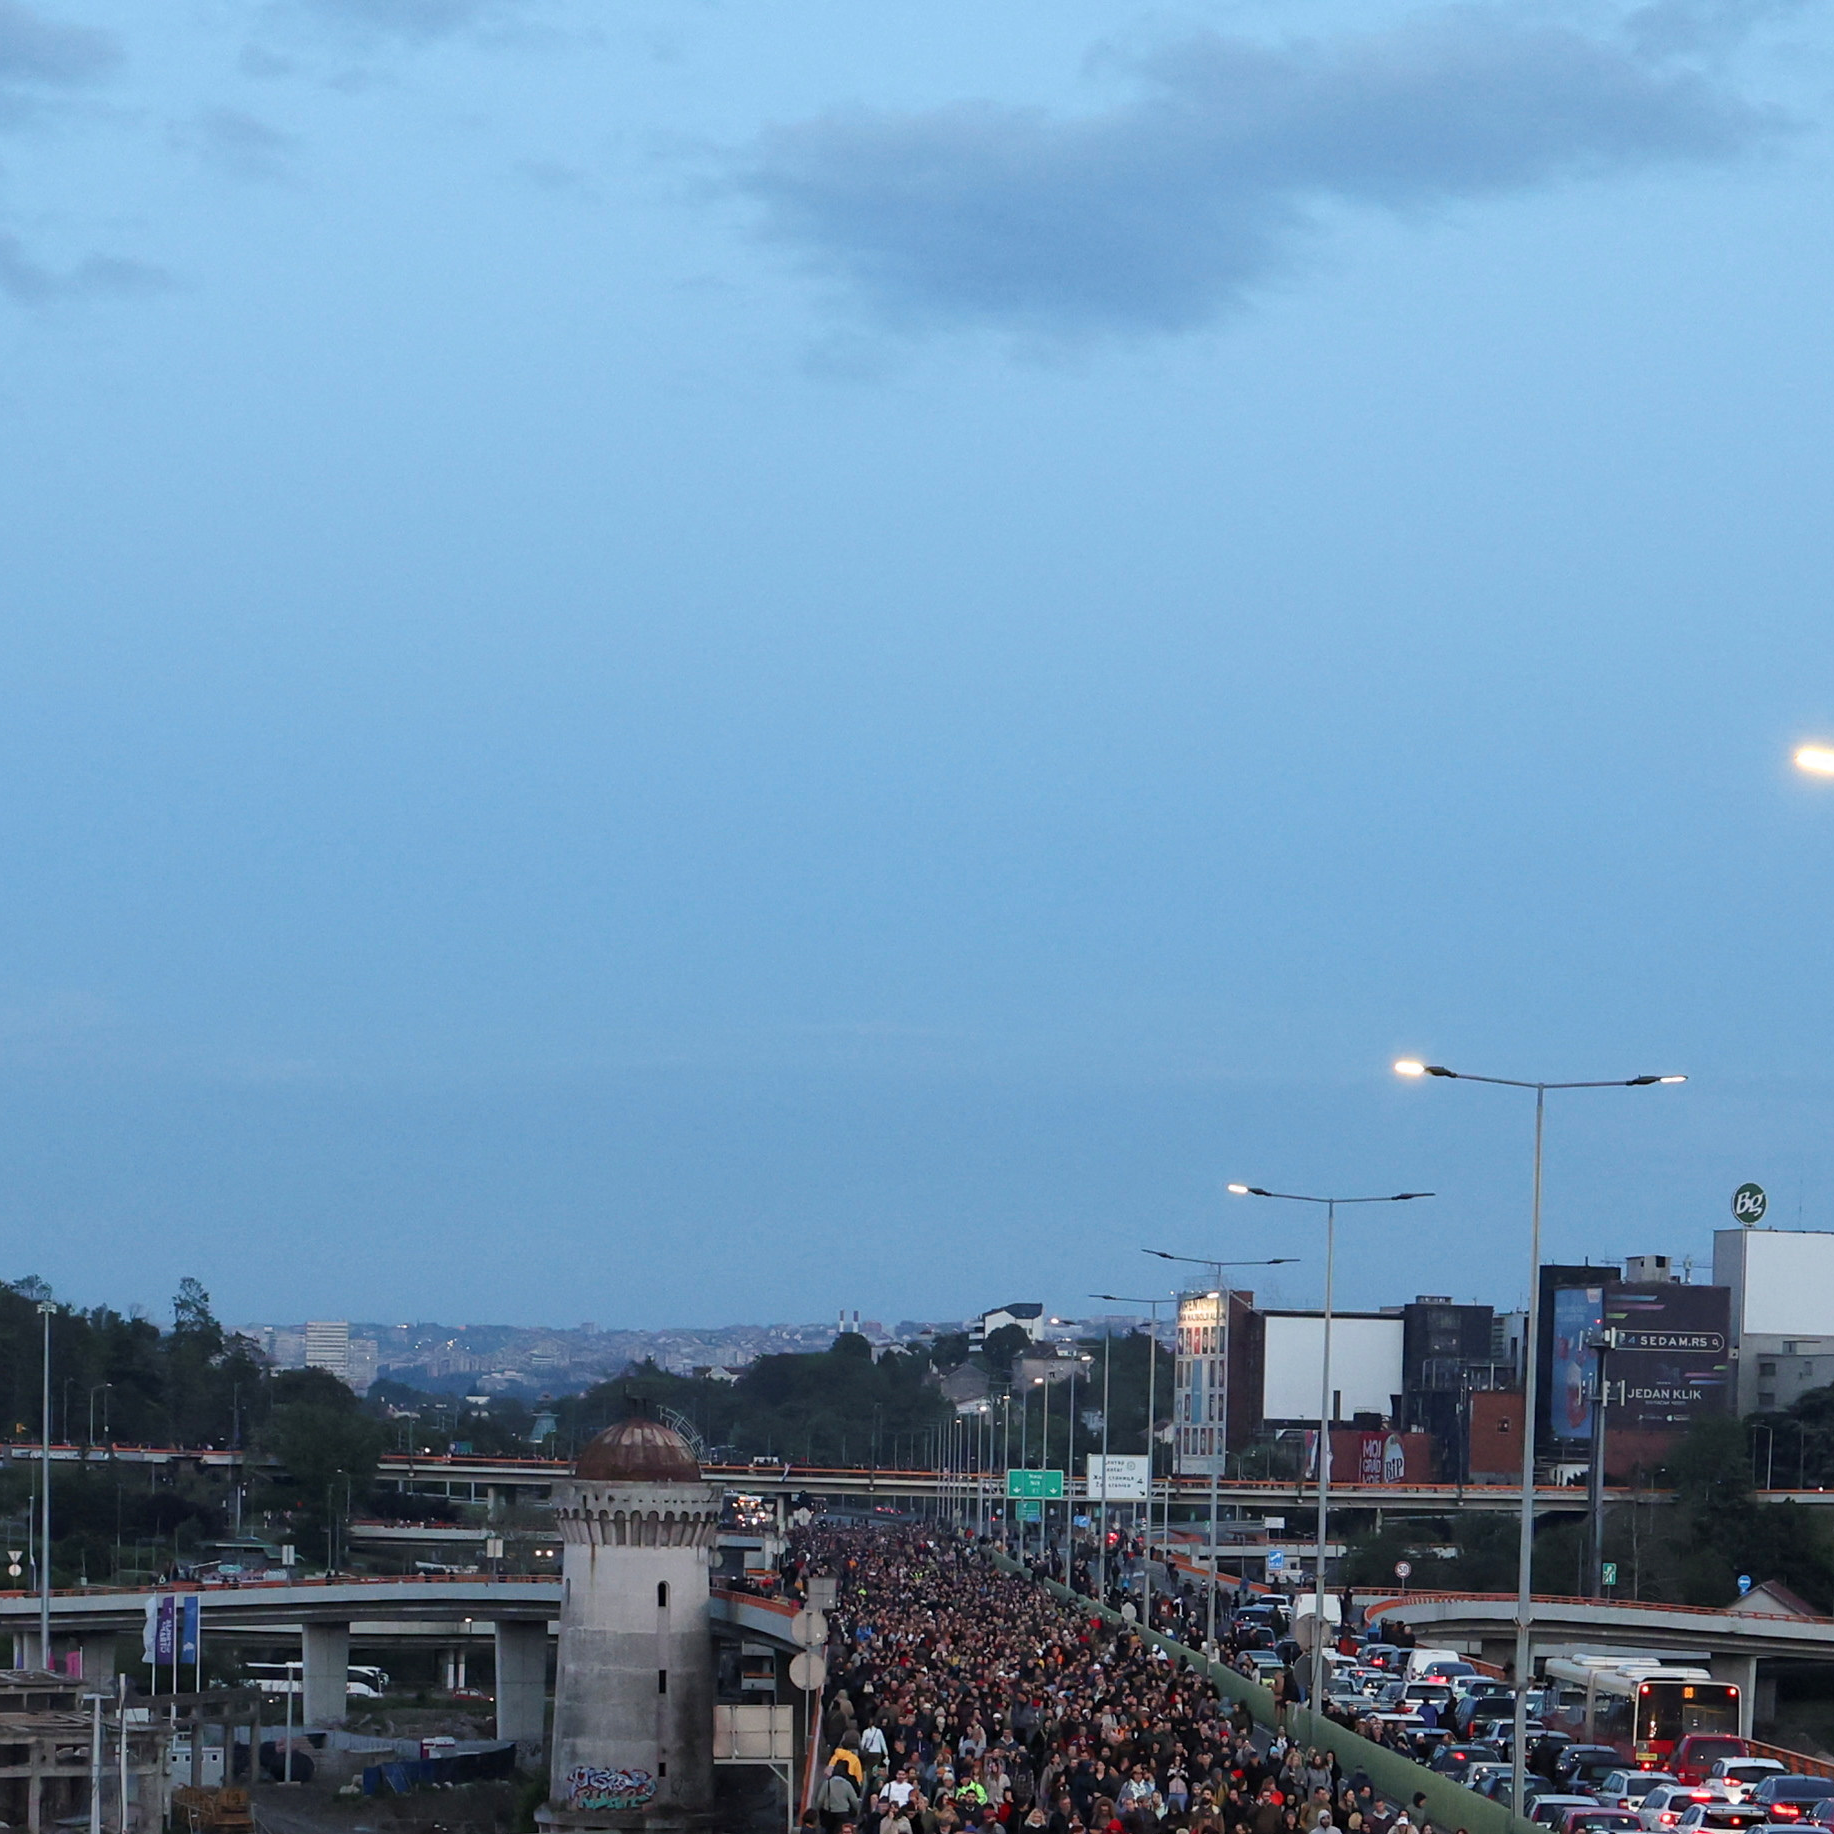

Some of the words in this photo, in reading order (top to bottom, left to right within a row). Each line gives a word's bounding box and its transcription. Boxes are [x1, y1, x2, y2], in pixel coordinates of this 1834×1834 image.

[1640, 1336, 1708, 1347] SEDAM.RS
[1627, 1388, 1670, 1399] JEDAN
[1673, 1389, 1702, 1400] KLIK
